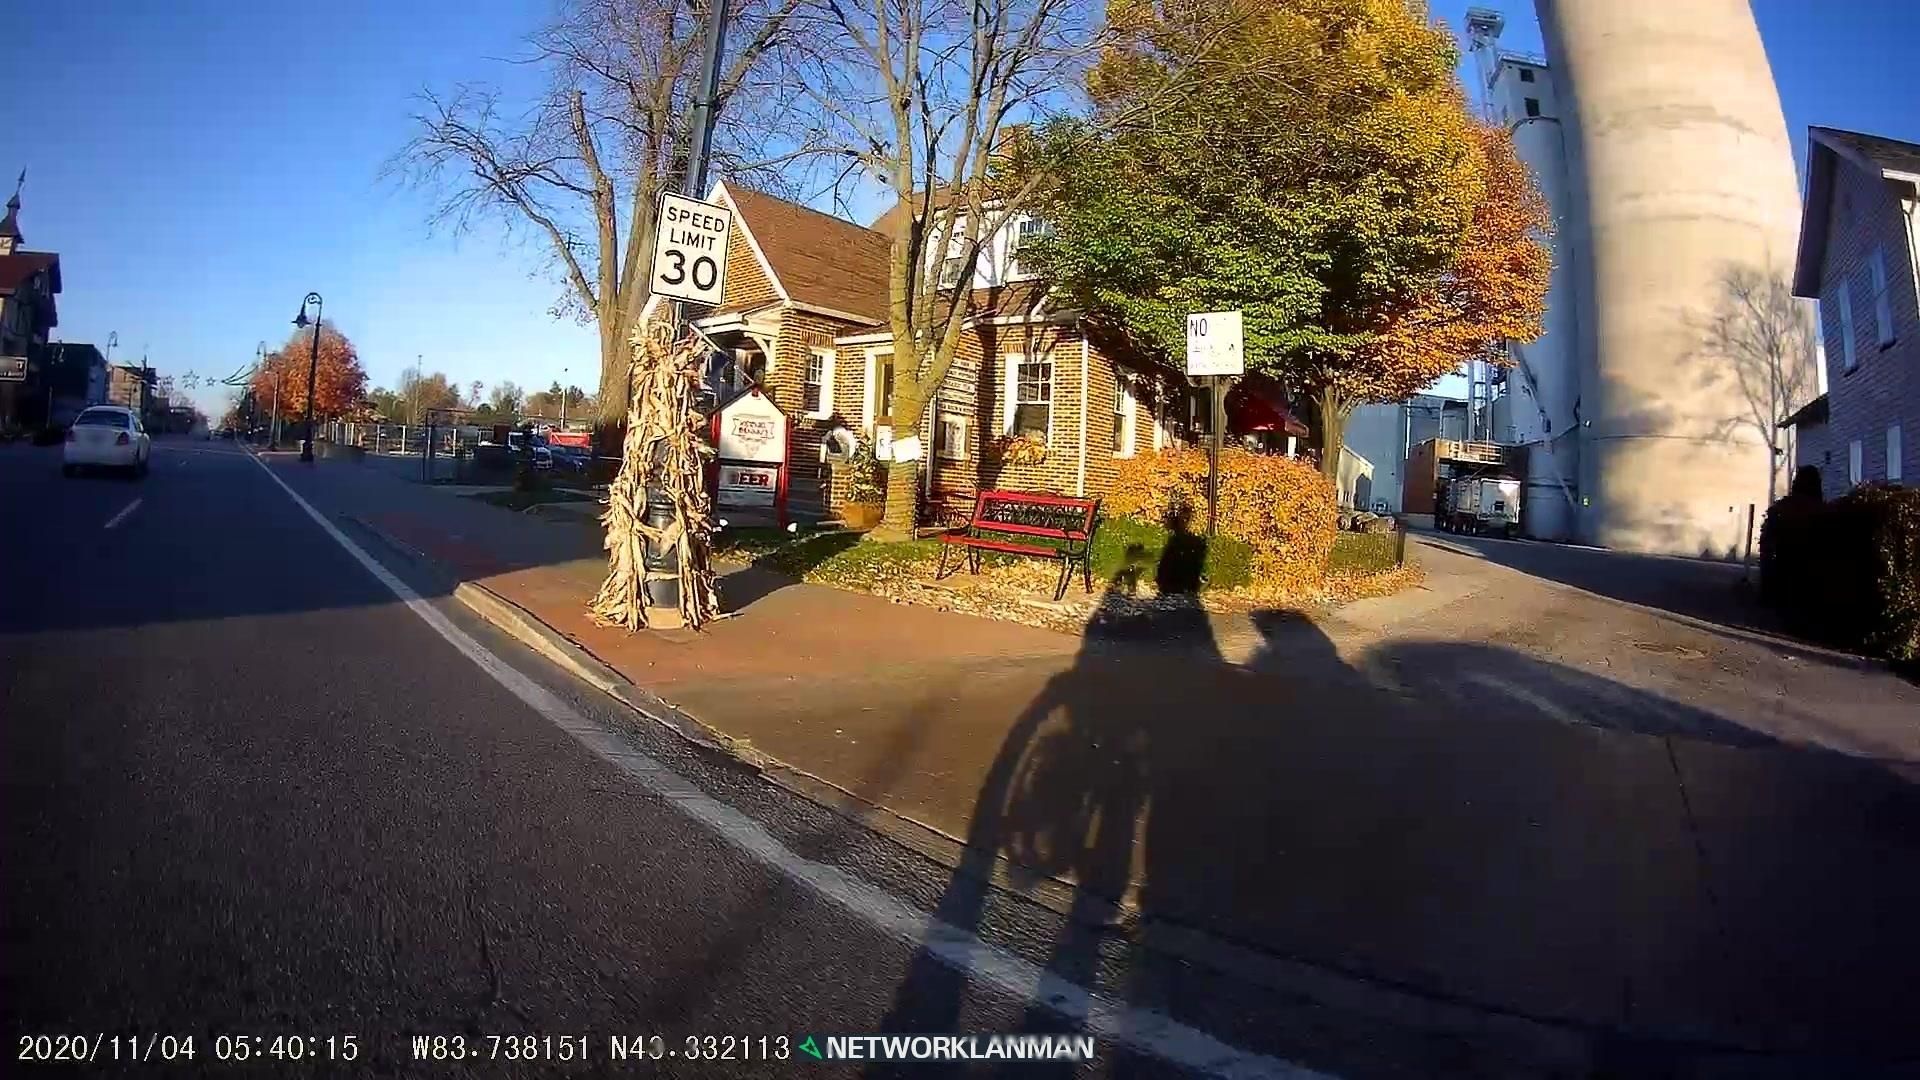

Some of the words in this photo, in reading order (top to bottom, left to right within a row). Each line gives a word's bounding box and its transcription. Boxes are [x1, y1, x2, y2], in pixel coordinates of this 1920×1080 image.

[667, 206, 725, 232] SPEED
[670, 228, 716, 251] LIMIT
[660, 249, 718, 291] 30
[1190, 318, 1208, 337] NO
